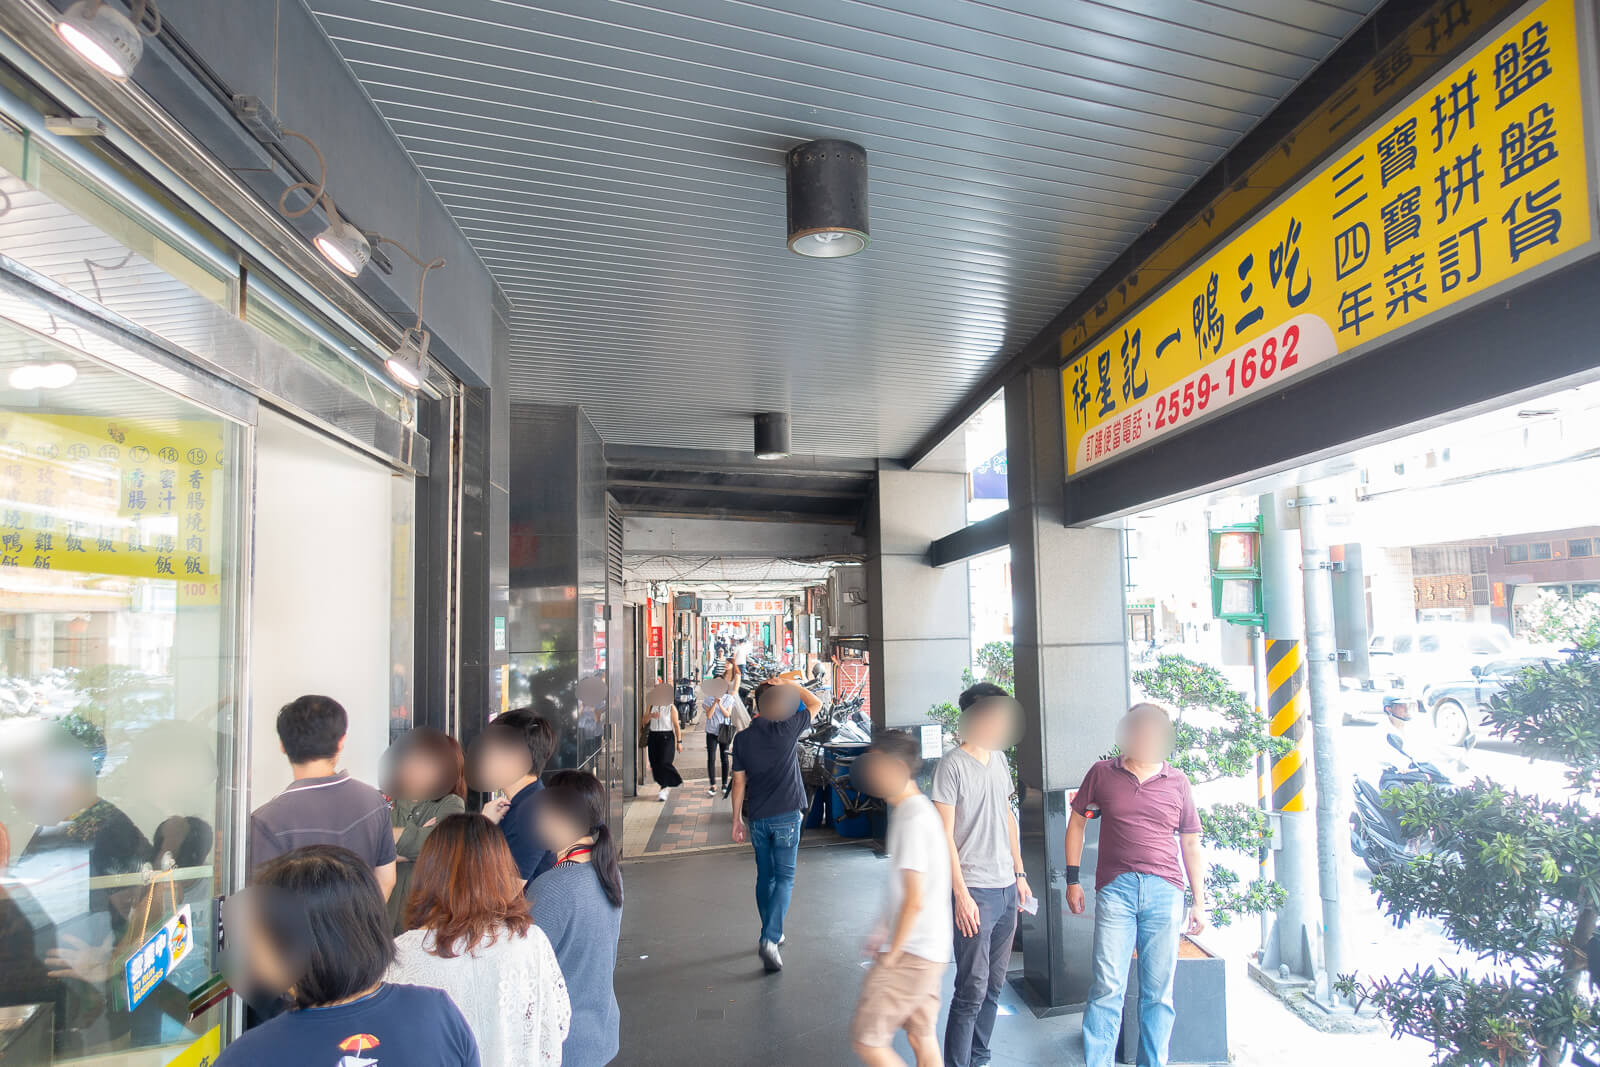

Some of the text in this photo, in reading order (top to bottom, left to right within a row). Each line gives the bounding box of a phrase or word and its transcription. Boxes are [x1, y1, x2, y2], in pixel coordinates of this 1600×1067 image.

[1332, 20, 1552, 220] 三寶拼盤
[1335, 103, 1559, 280] 四寶拼盤
[1337, 178, 1562, 337] 年菜訂貨
[1071, 217, 1312, 431] 祥星記一鴨三吃
[1154, 325, 1301, 429] 2559-1682
[127, 468, 147, 552] 香腸飯
[155, 469, 177, 575] 蜜汁腸飯
[184, 469, 205, 575] 香腸燒肉飯
